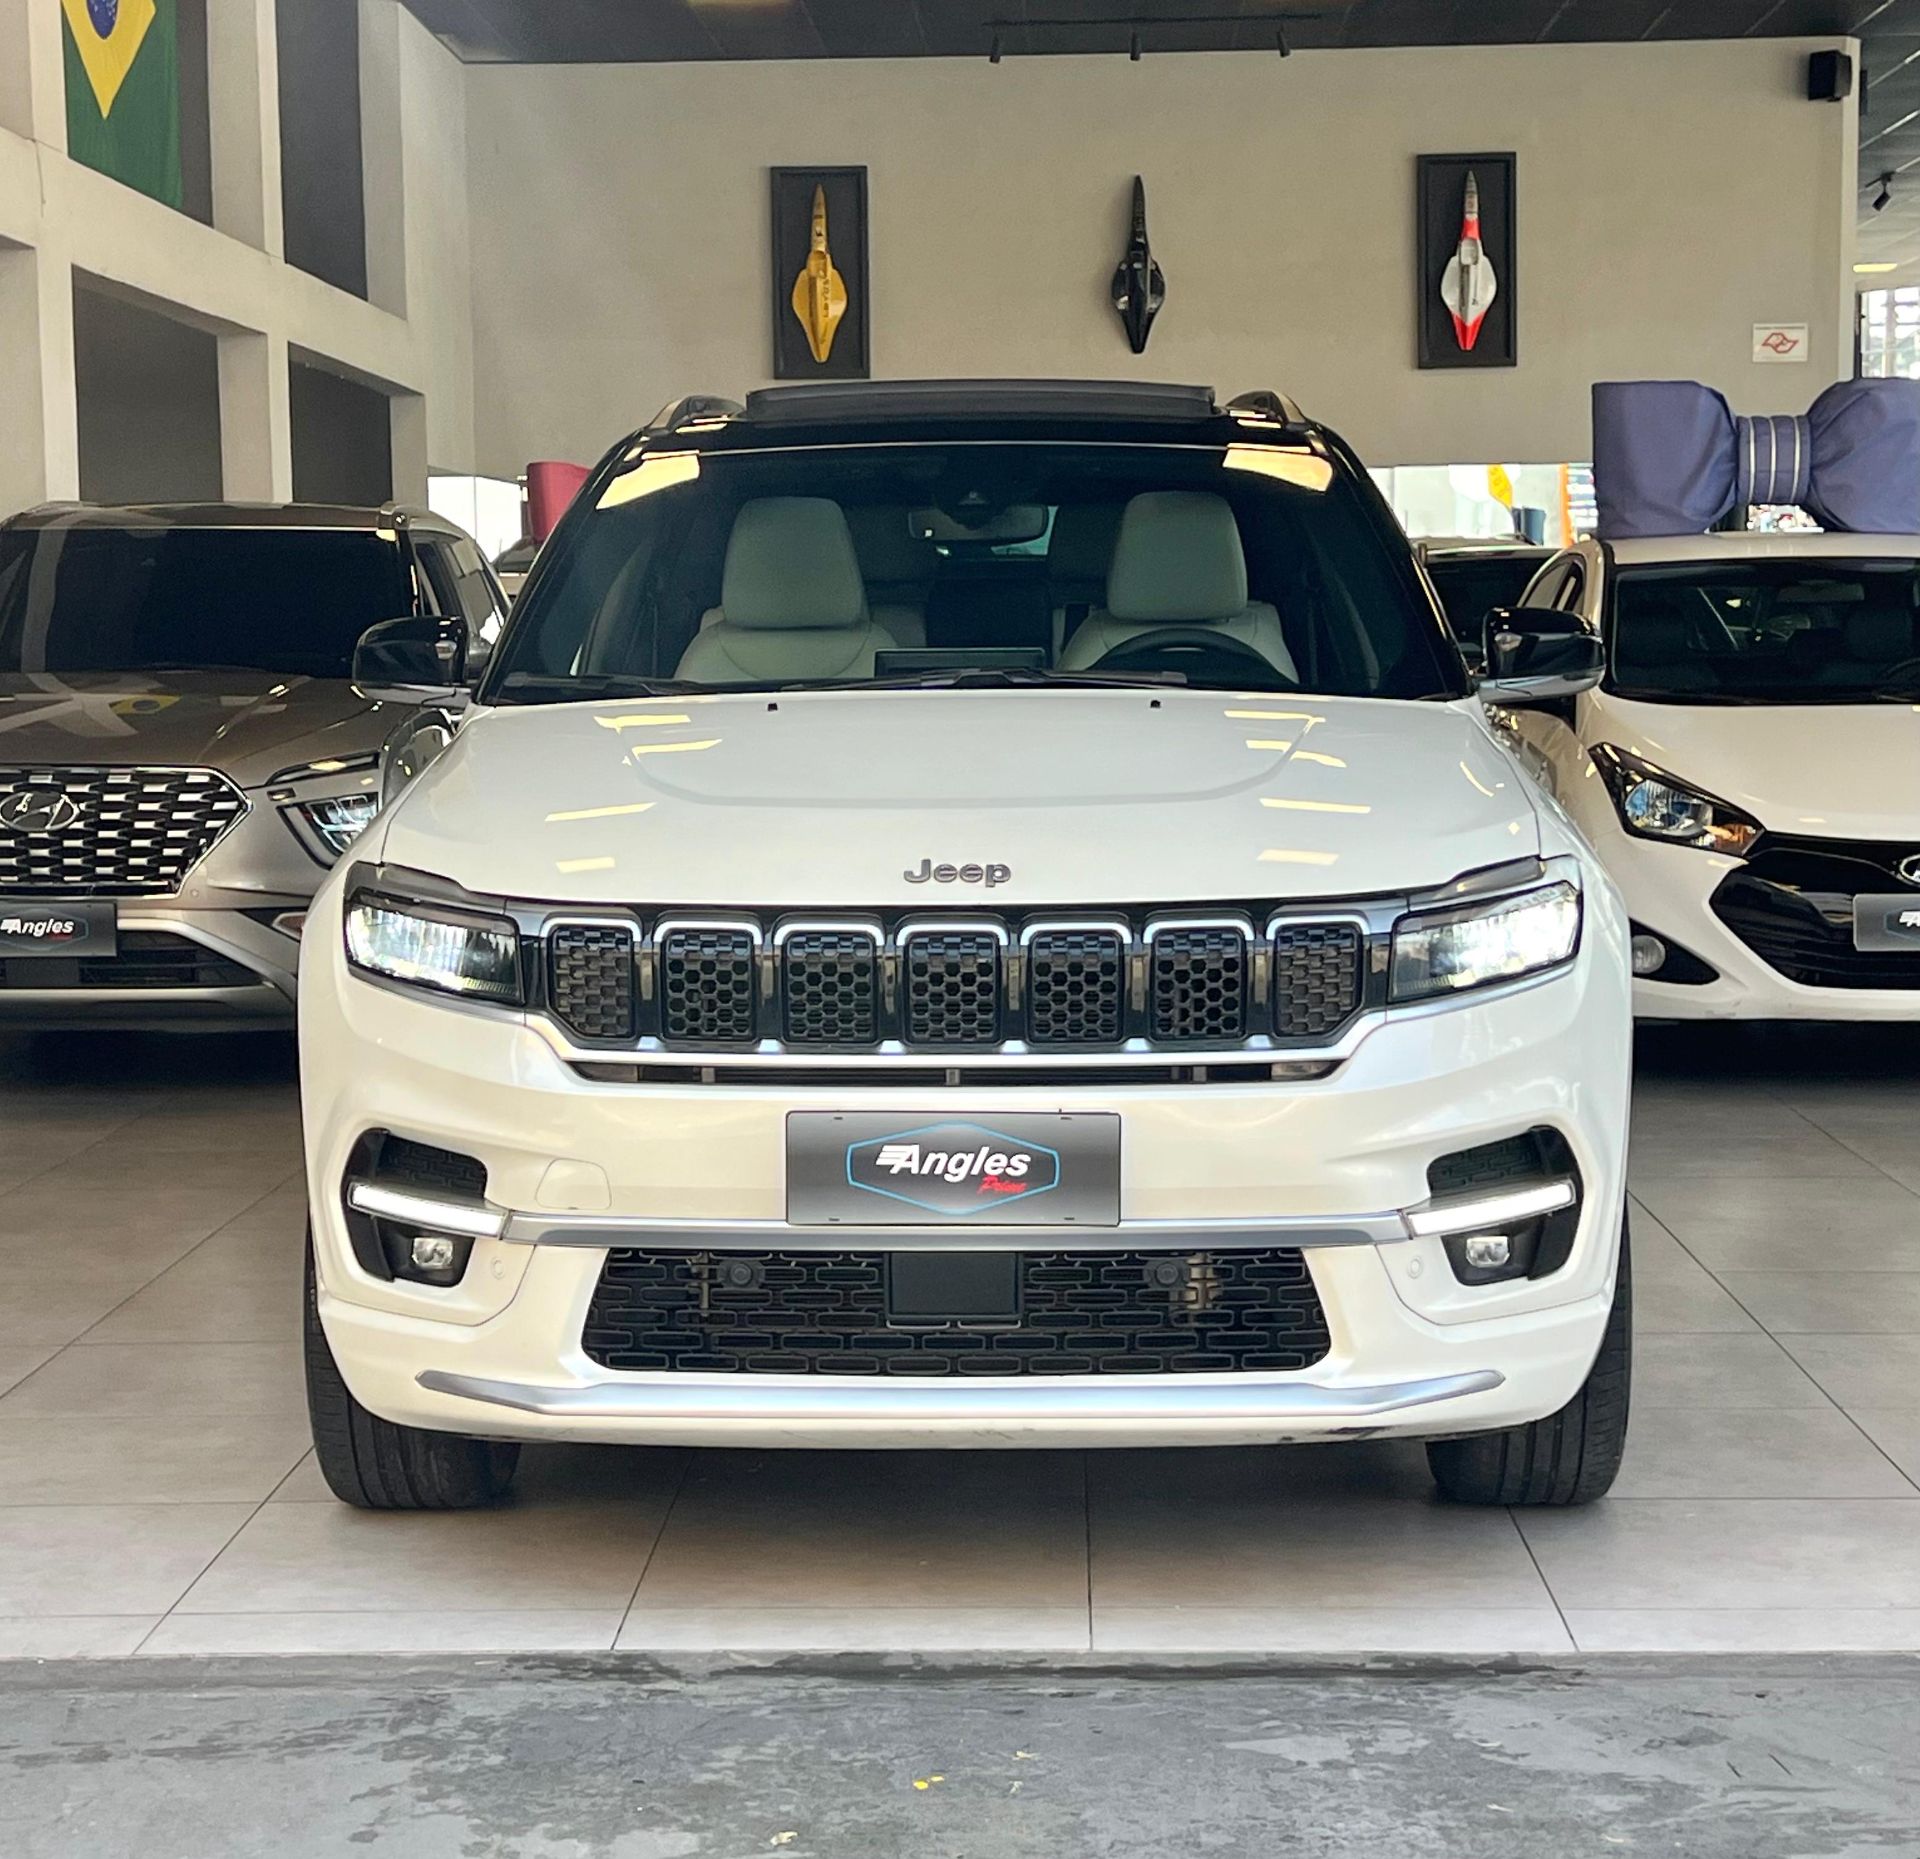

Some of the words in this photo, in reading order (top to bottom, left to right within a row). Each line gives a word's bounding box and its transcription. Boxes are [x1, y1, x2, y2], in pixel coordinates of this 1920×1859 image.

[903, 858, 1011, 888] Jeep
[0, 918, 75, 938] Angles
[876, 1144, 1031, 1183] Angles
